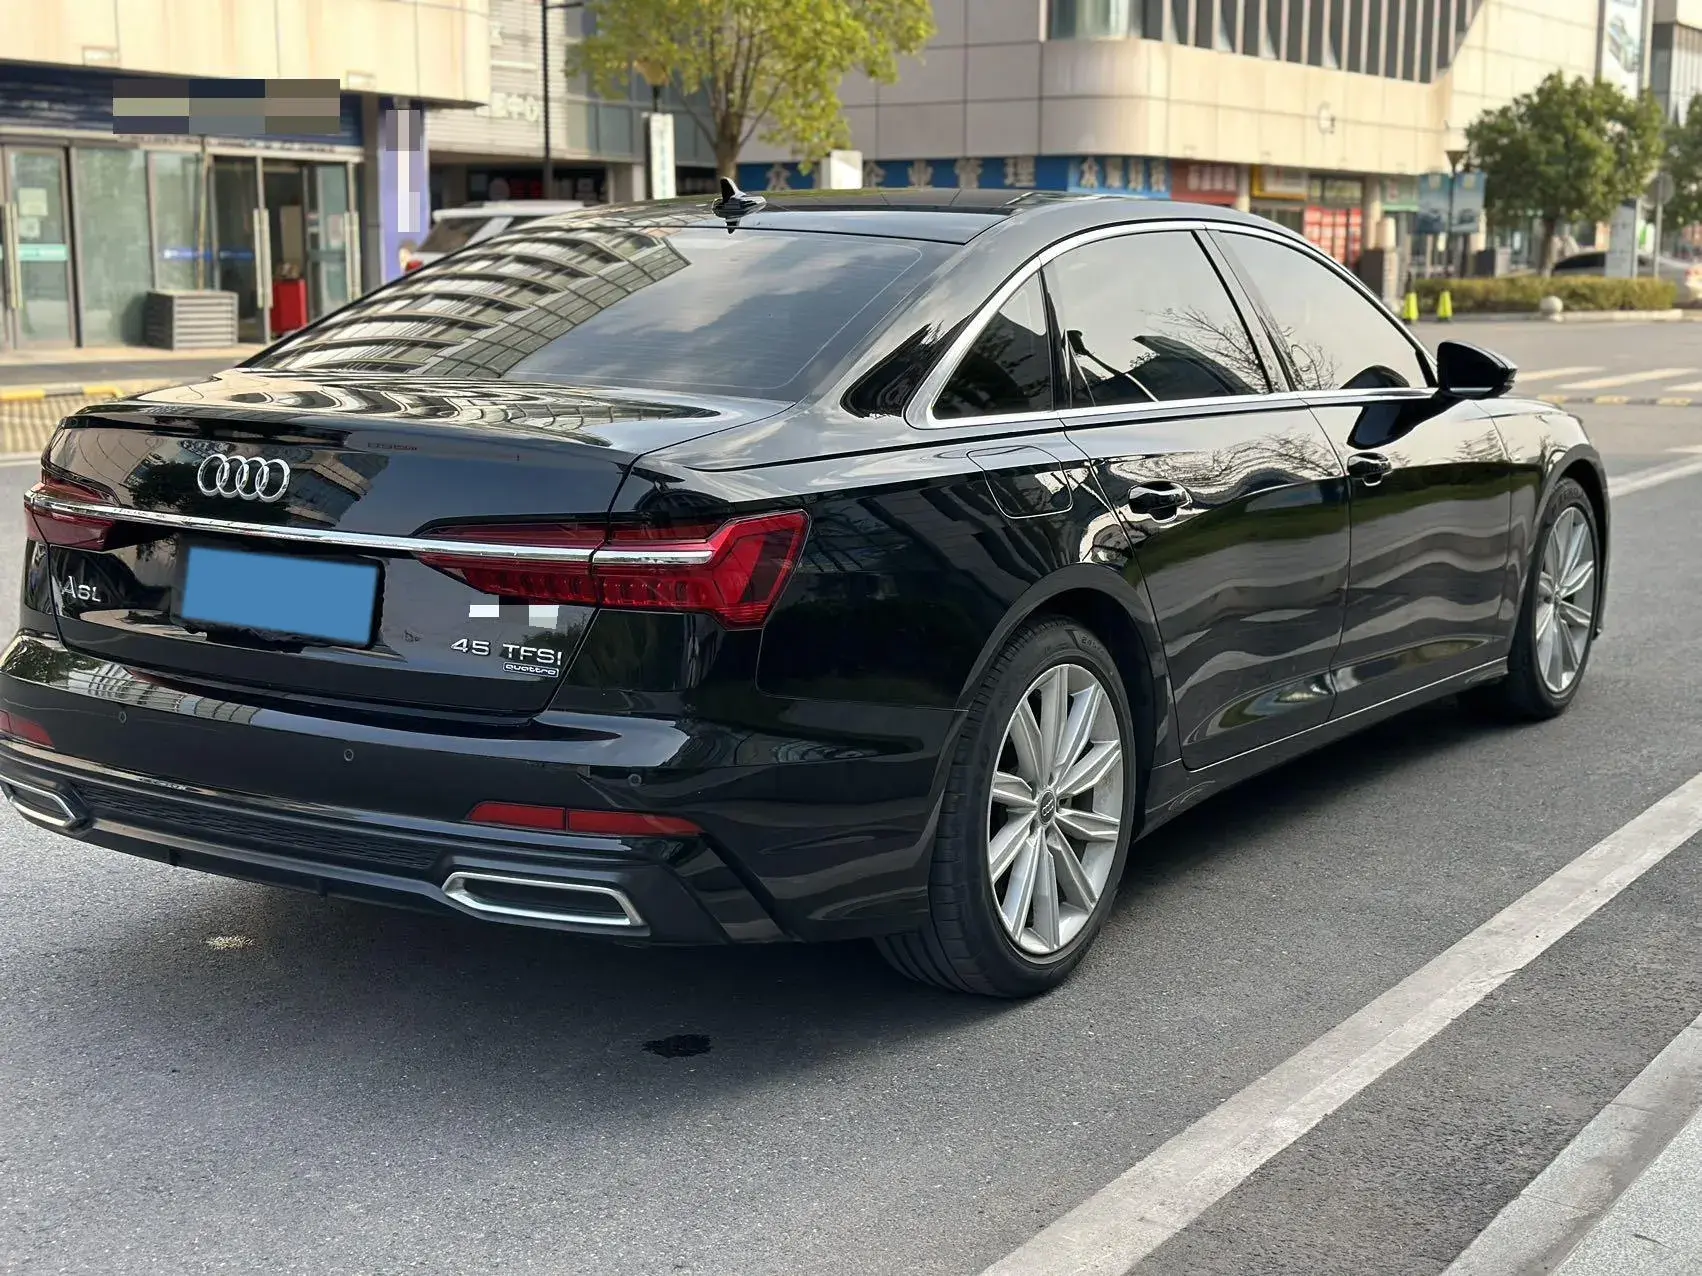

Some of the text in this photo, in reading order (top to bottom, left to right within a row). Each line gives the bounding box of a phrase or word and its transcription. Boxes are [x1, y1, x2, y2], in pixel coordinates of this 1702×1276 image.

[450, 638, 562, 665] 45 TFSI
[504, 662, 557, 676] quattro
